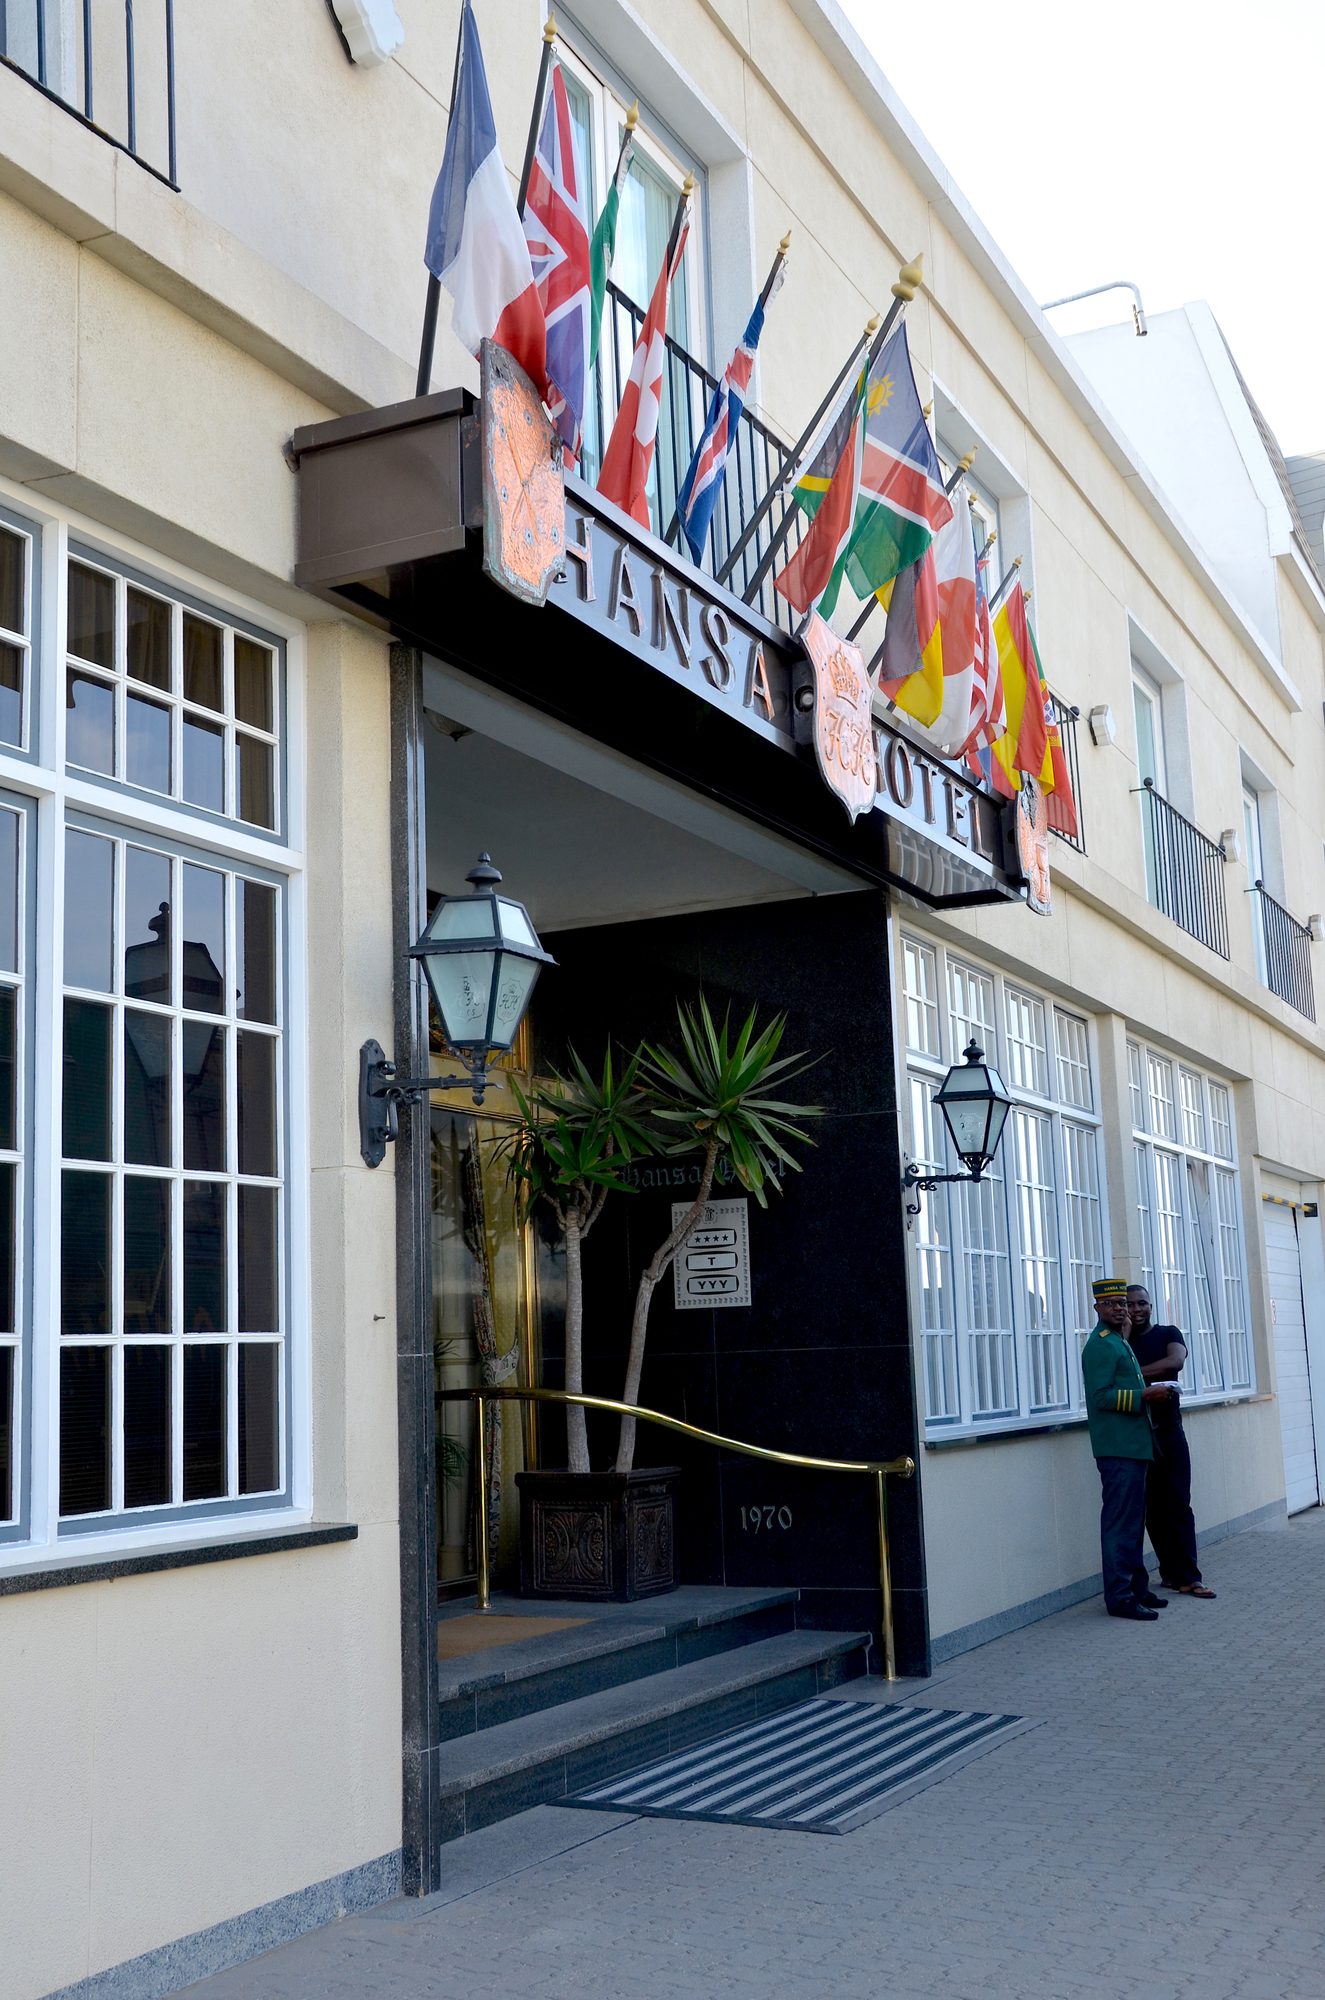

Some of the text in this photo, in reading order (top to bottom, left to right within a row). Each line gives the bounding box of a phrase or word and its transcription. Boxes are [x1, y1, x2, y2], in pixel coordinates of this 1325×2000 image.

[564, 516, 776, 721] HANSA
[707, 1257, 716, 1266] T
[737, 1502, 782, 1528] 1970
